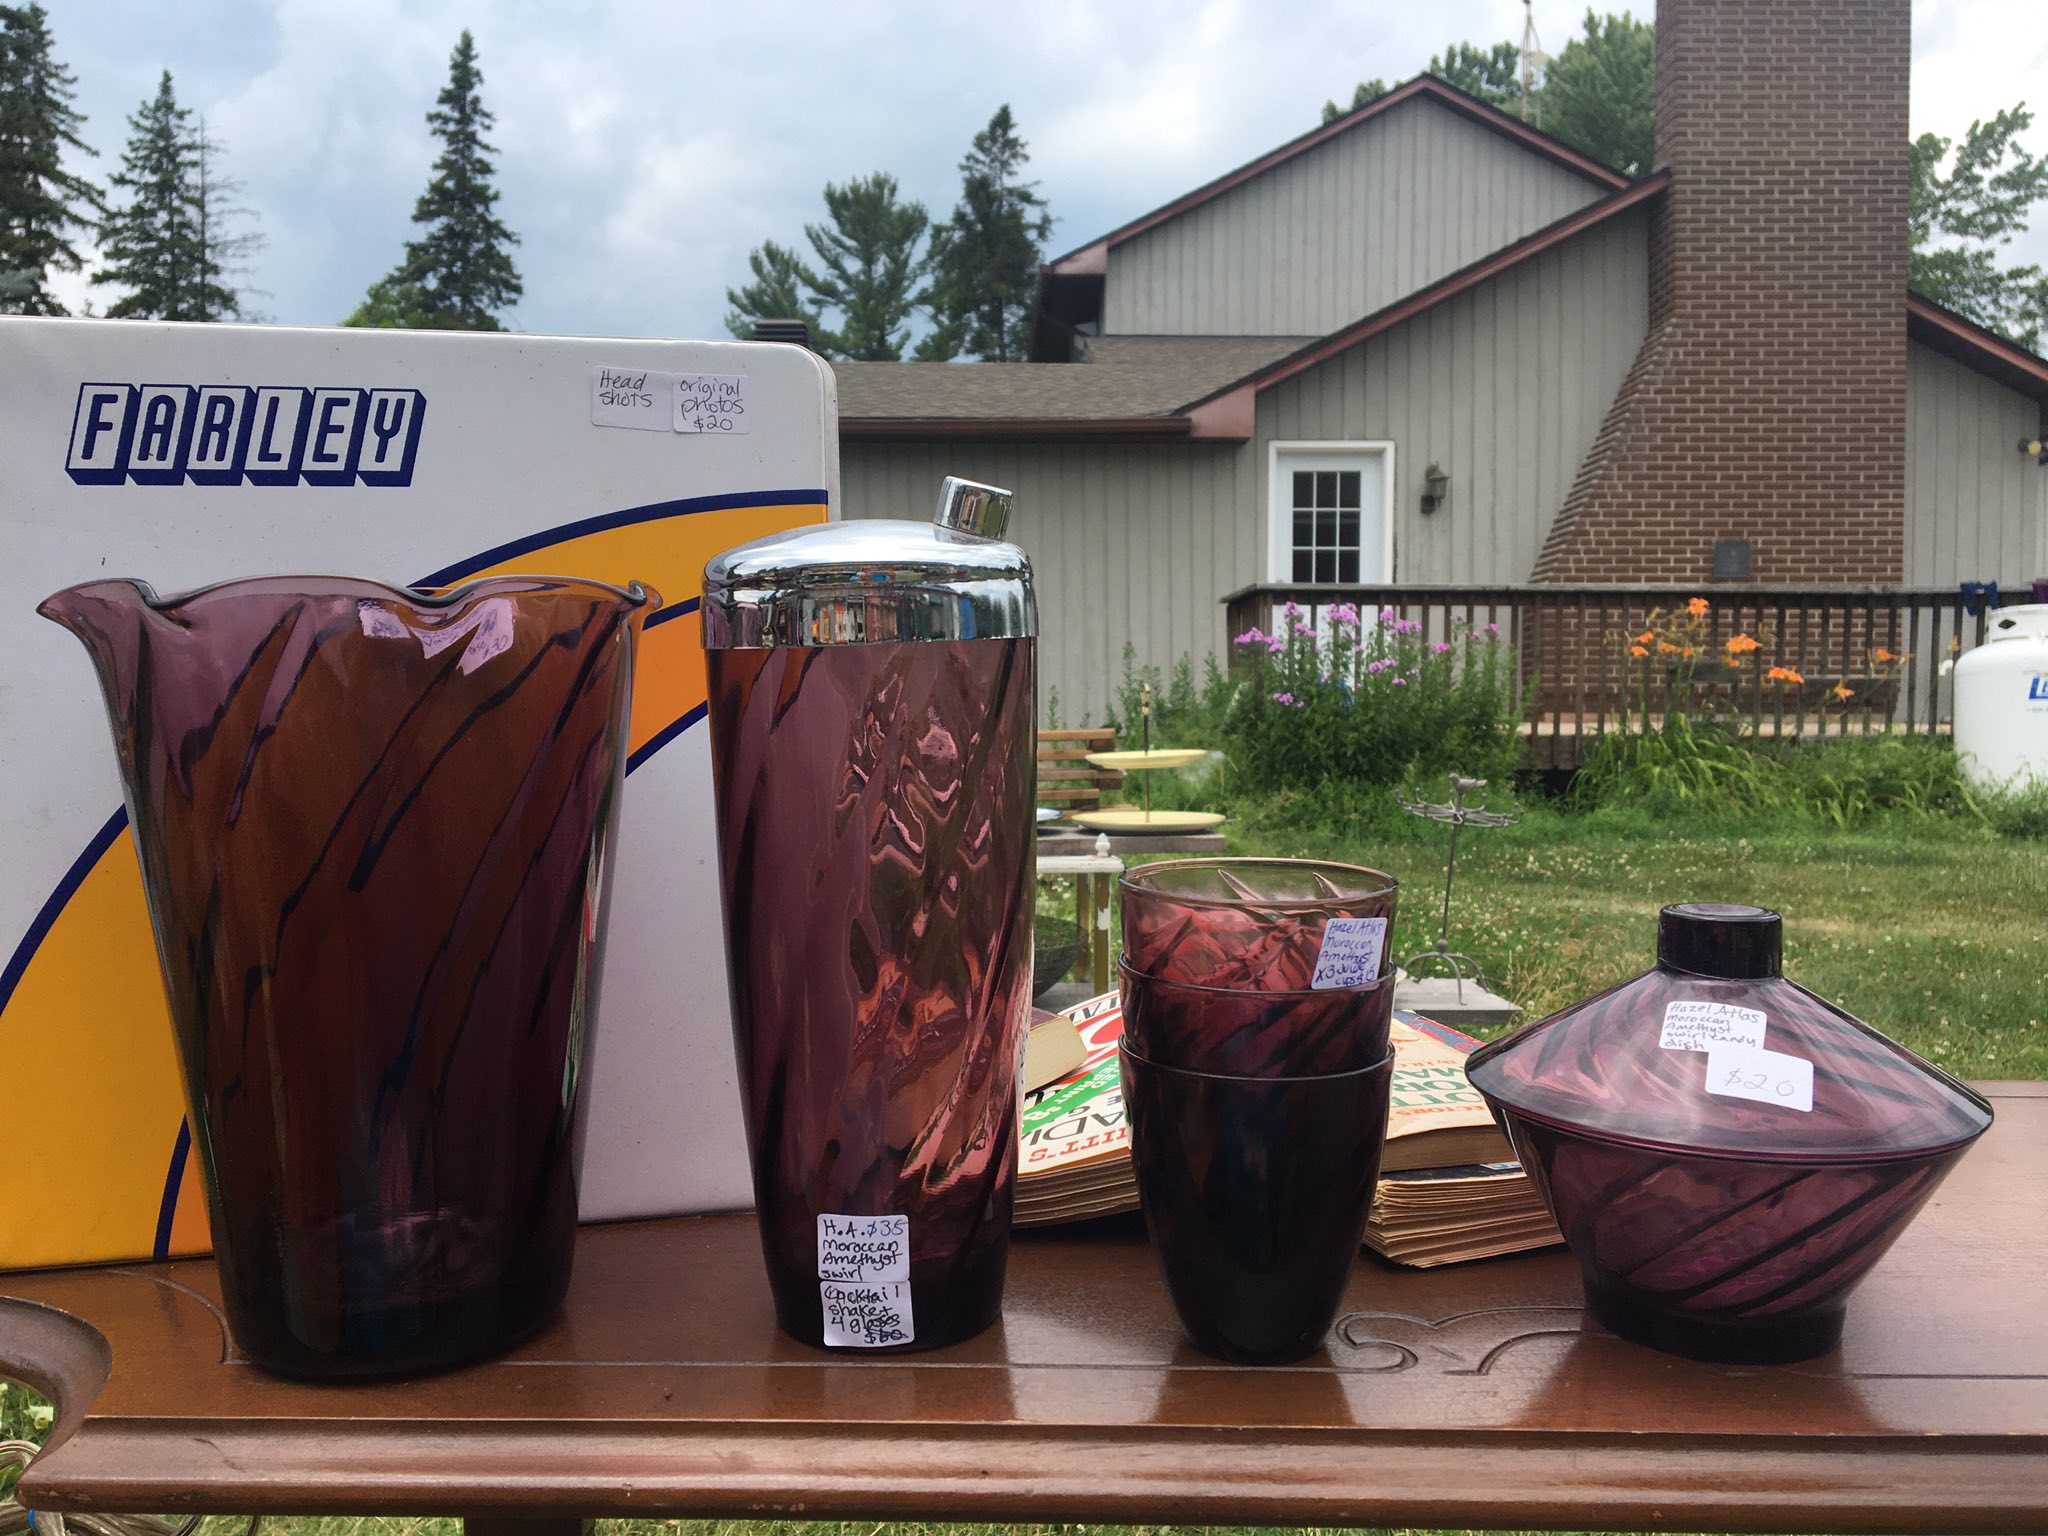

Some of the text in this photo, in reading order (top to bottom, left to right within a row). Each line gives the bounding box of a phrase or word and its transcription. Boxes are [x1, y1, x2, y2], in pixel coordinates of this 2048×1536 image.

[600, 371, 647, 391] Head
[680, 377, 740, 397] original
[599, 390, 652, 408] shots
[681, 397, 744, 420] photos
[72, 386, 416, 470] FARLEY
[694, 415, 733, 433] $20
[1670, 1003, 1760, 1023] Hazel Atlas
[1664, 1022, 1733, 1034] Amethyst
[1724, 1067, 1795, 1097] $20
[867, 1219, 908, 1238] $35
[823, 1250, 903, 1271] Amethyst
[821, 1265, 862, 1281] swirl
